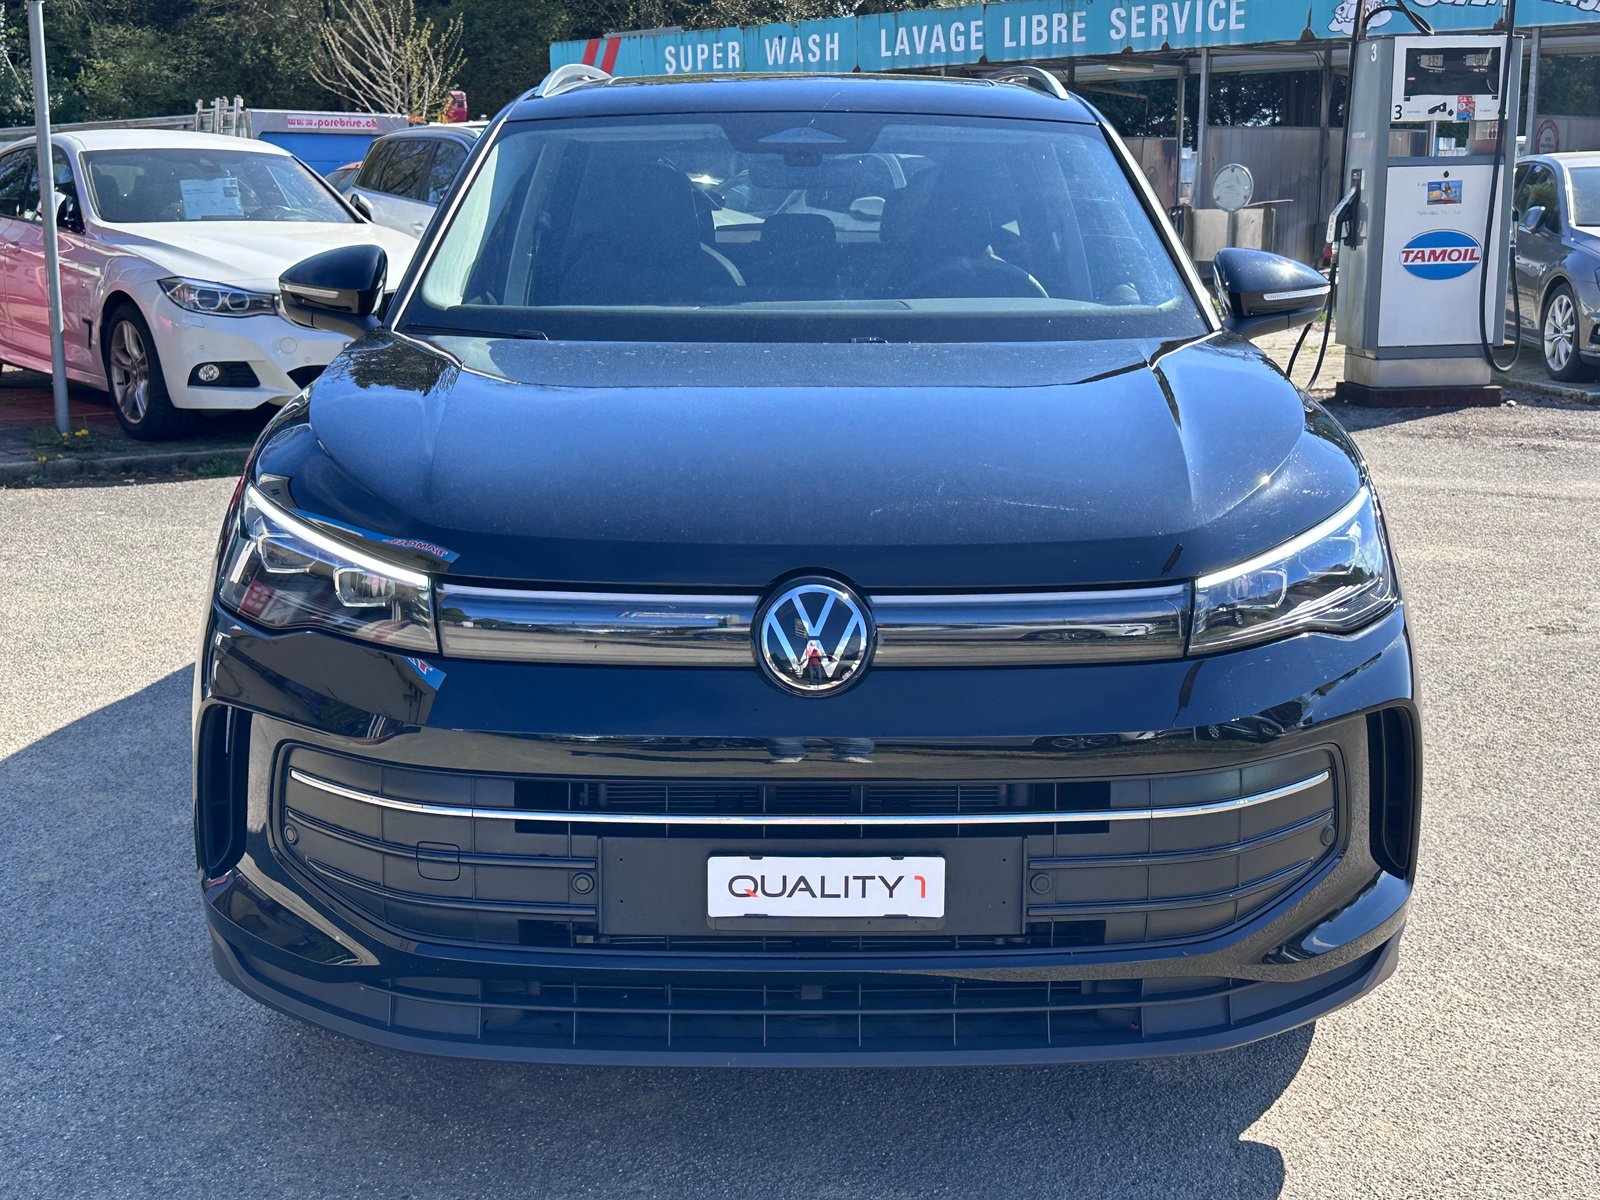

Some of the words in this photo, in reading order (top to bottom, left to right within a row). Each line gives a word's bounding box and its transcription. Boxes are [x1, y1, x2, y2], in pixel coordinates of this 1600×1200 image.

[664, 41, 740, 74] SUPER
[764, 32, 839, 66] WASH
[880, 20, 984, 57] LAVAGE
[1004, 11, 1087, 48] LIBRE
[1109, 0, 1246, 41] SERVICE
[1370, 43, 1378, 63] 3
[1394, 104, 1403, 120] 3
[1401, 248, 1480, 263] TAMOIL
[728, 875, 905, 898] QUALITY
[914, 875, 926, 898] 1
